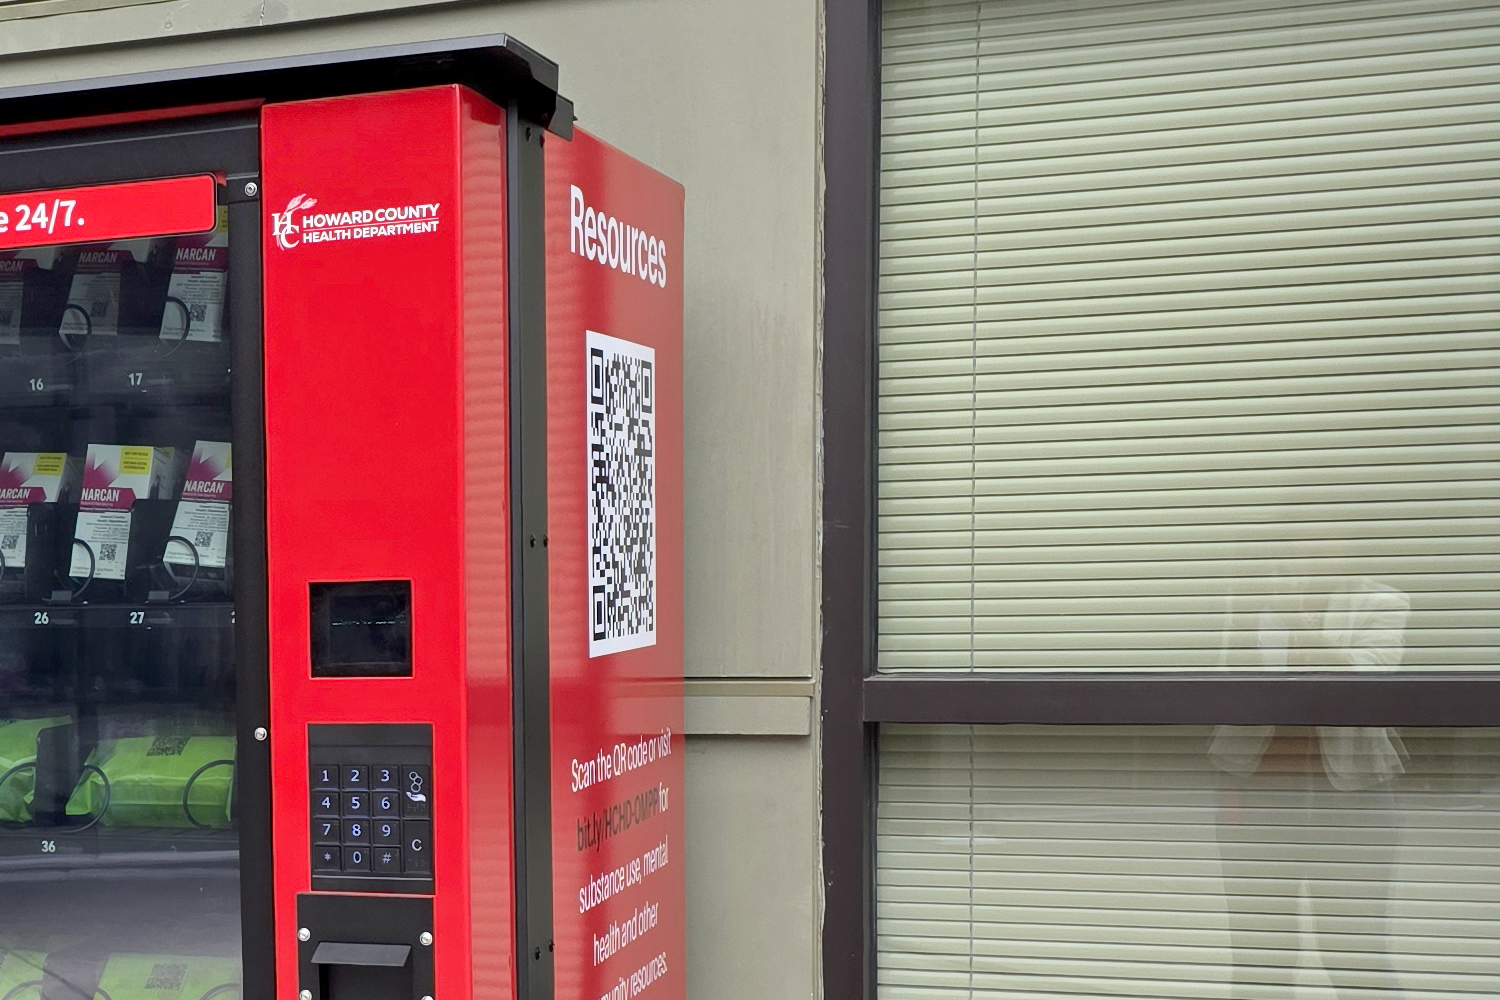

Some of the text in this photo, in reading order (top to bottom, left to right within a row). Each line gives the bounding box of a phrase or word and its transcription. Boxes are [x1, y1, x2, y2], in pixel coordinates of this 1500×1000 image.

[15, 199, 85, 234] 24/7.
[303, 203, 440, 229] HOWARD COUNTY
[303, 221, 439, 243] HEALTH DEPARTMENT
[570, 184, 666, 288] Resources
[78, 251, 117, 264] NARCAN
[175, 247, 217, 261] NARCAN
[29, 378, 44, 391] 16
[129, 373, 143, 386] 17
[184, 480, 224, 493] NARCAN
[81, 487, 120, 502] NARCAN
[34, 612, 49, 625] 26
[130, 612, 145, 625] 27
[571, 727, 672, 792] Scan the QR code or visit
[322, 770, 390, 782] 1 2 3
[322, 797, 391, 809] 4 5 6
[659, 781, 669, 813] for
[323, 824, 391, 836] 7 8 9
[41, 840, 56, 852] 36
[412, 839, 422, 851] C
[353, 851, 362, 863] 0
[579, 834, 669, 914] substance use, mental
[593, 901, 659, 966] health and other
